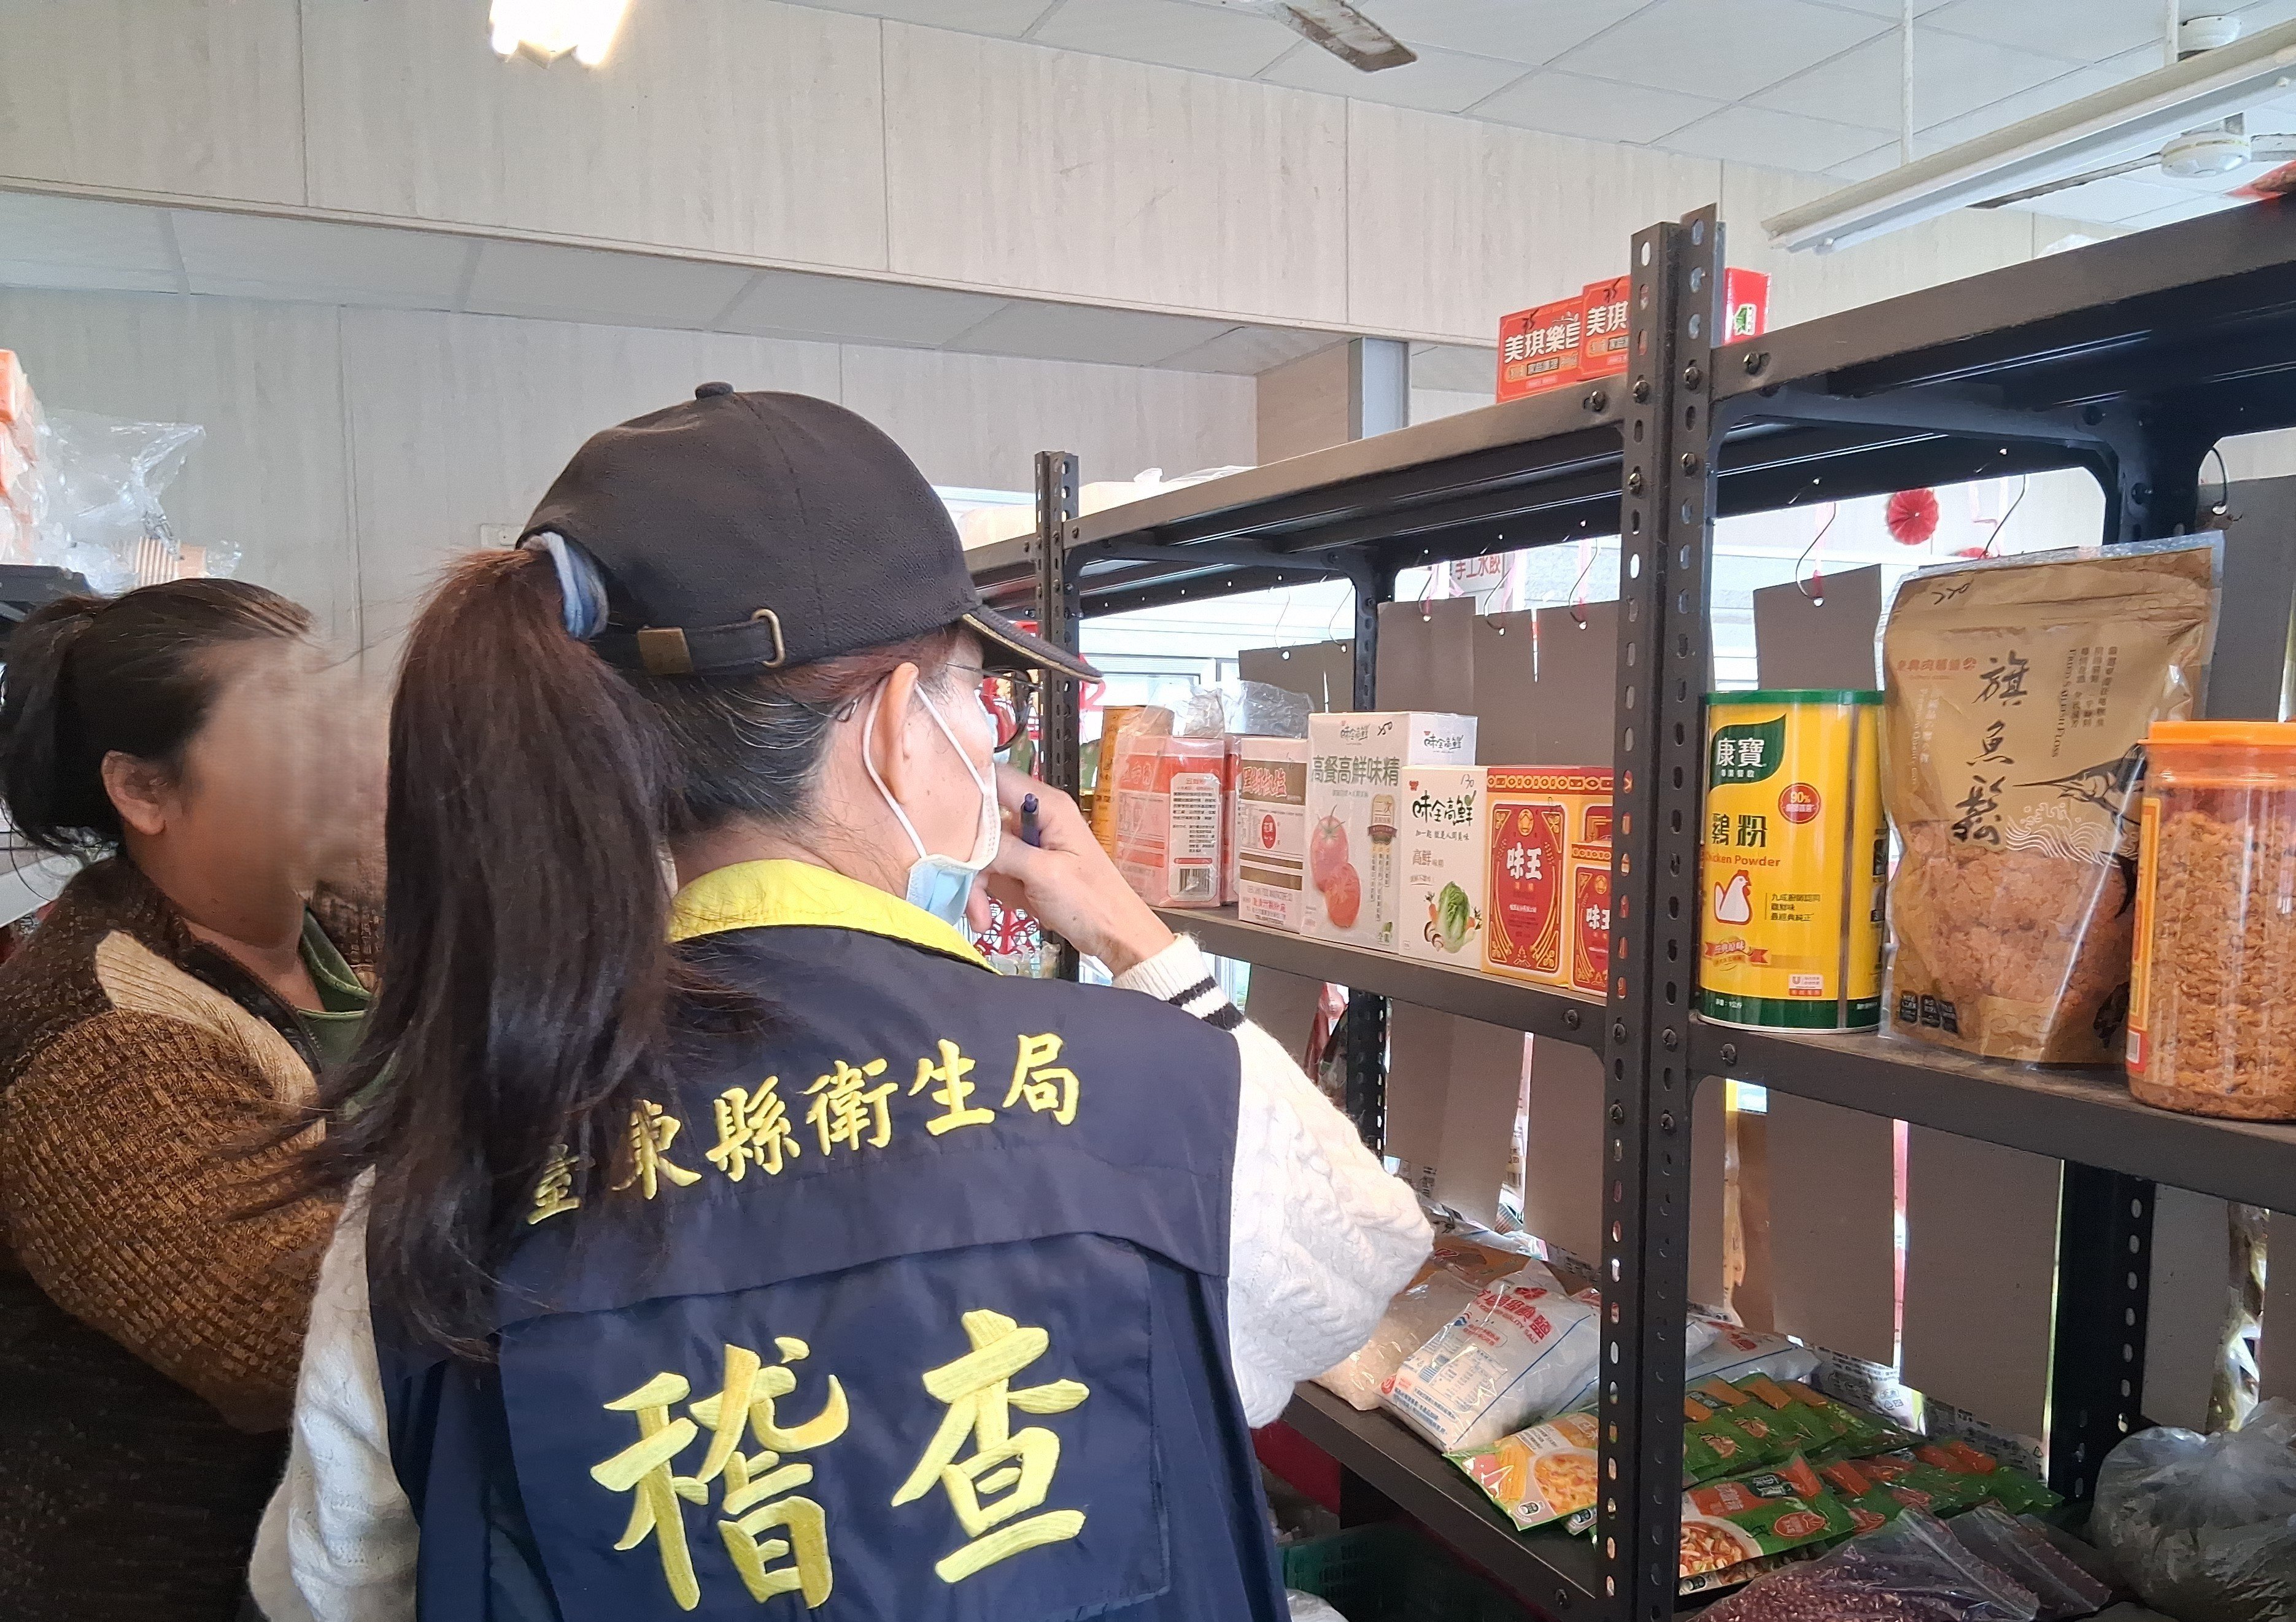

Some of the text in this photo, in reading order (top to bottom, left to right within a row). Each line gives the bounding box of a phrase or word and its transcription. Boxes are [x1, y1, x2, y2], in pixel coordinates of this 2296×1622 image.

[1716, 737, 1765, 767] 康寶
[1412, 790, 1477, 826] 味全高鮮
[1507, 842, 1543, 881] 味王
[1735, 855, 1780, 867] Powder
[590, 1309, 1090, 1612] 稽查
